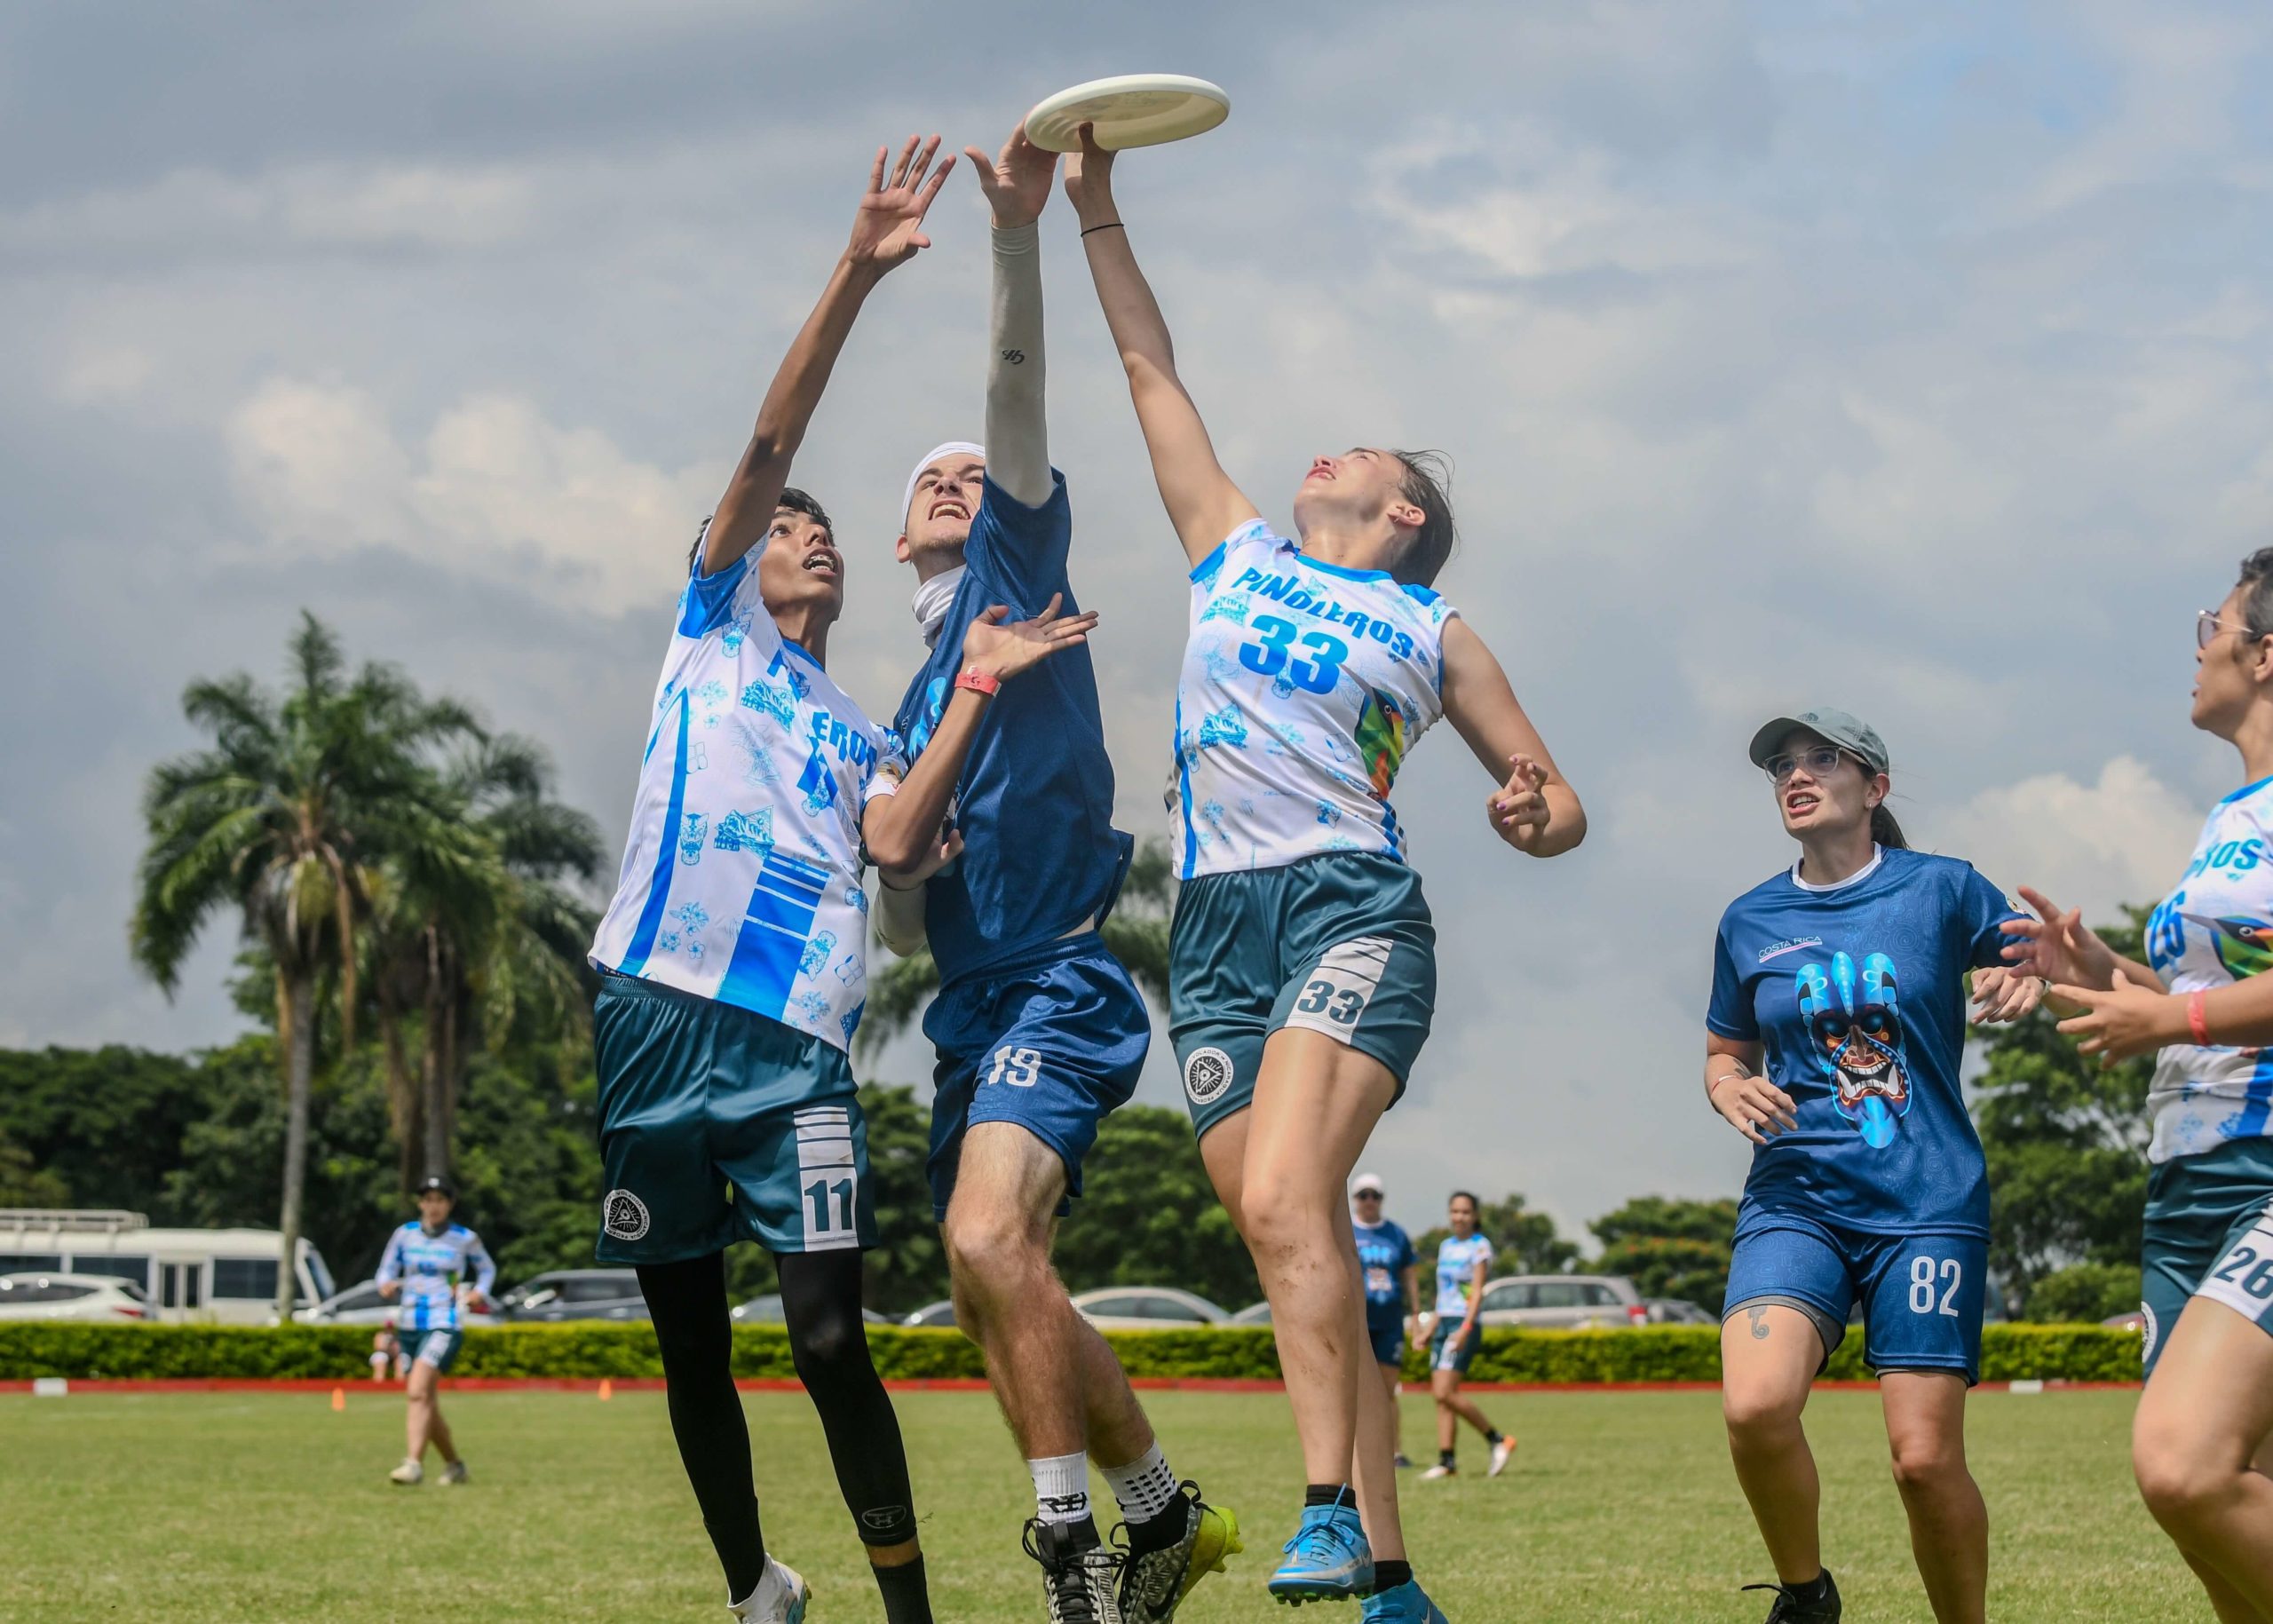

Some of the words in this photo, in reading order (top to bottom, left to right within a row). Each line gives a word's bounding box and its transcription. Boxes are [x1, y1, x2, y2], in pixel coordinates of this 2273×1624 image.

[1231, 567, 1414, 660] PINOLEROS
[1238, 614, 1349, 695] 33
[1758, 939, 1792, 958] COSTA
[1794, 936, 1822, 945] RICA
[1297, 979, 1366, 1025] 33
[987, 1044, 1042, 1088] 19
[804, 1178, 853, 1232] 11
[1909, 1256, 1961, 1318] 82
[2214, 1246, 2273, 1299] 26
